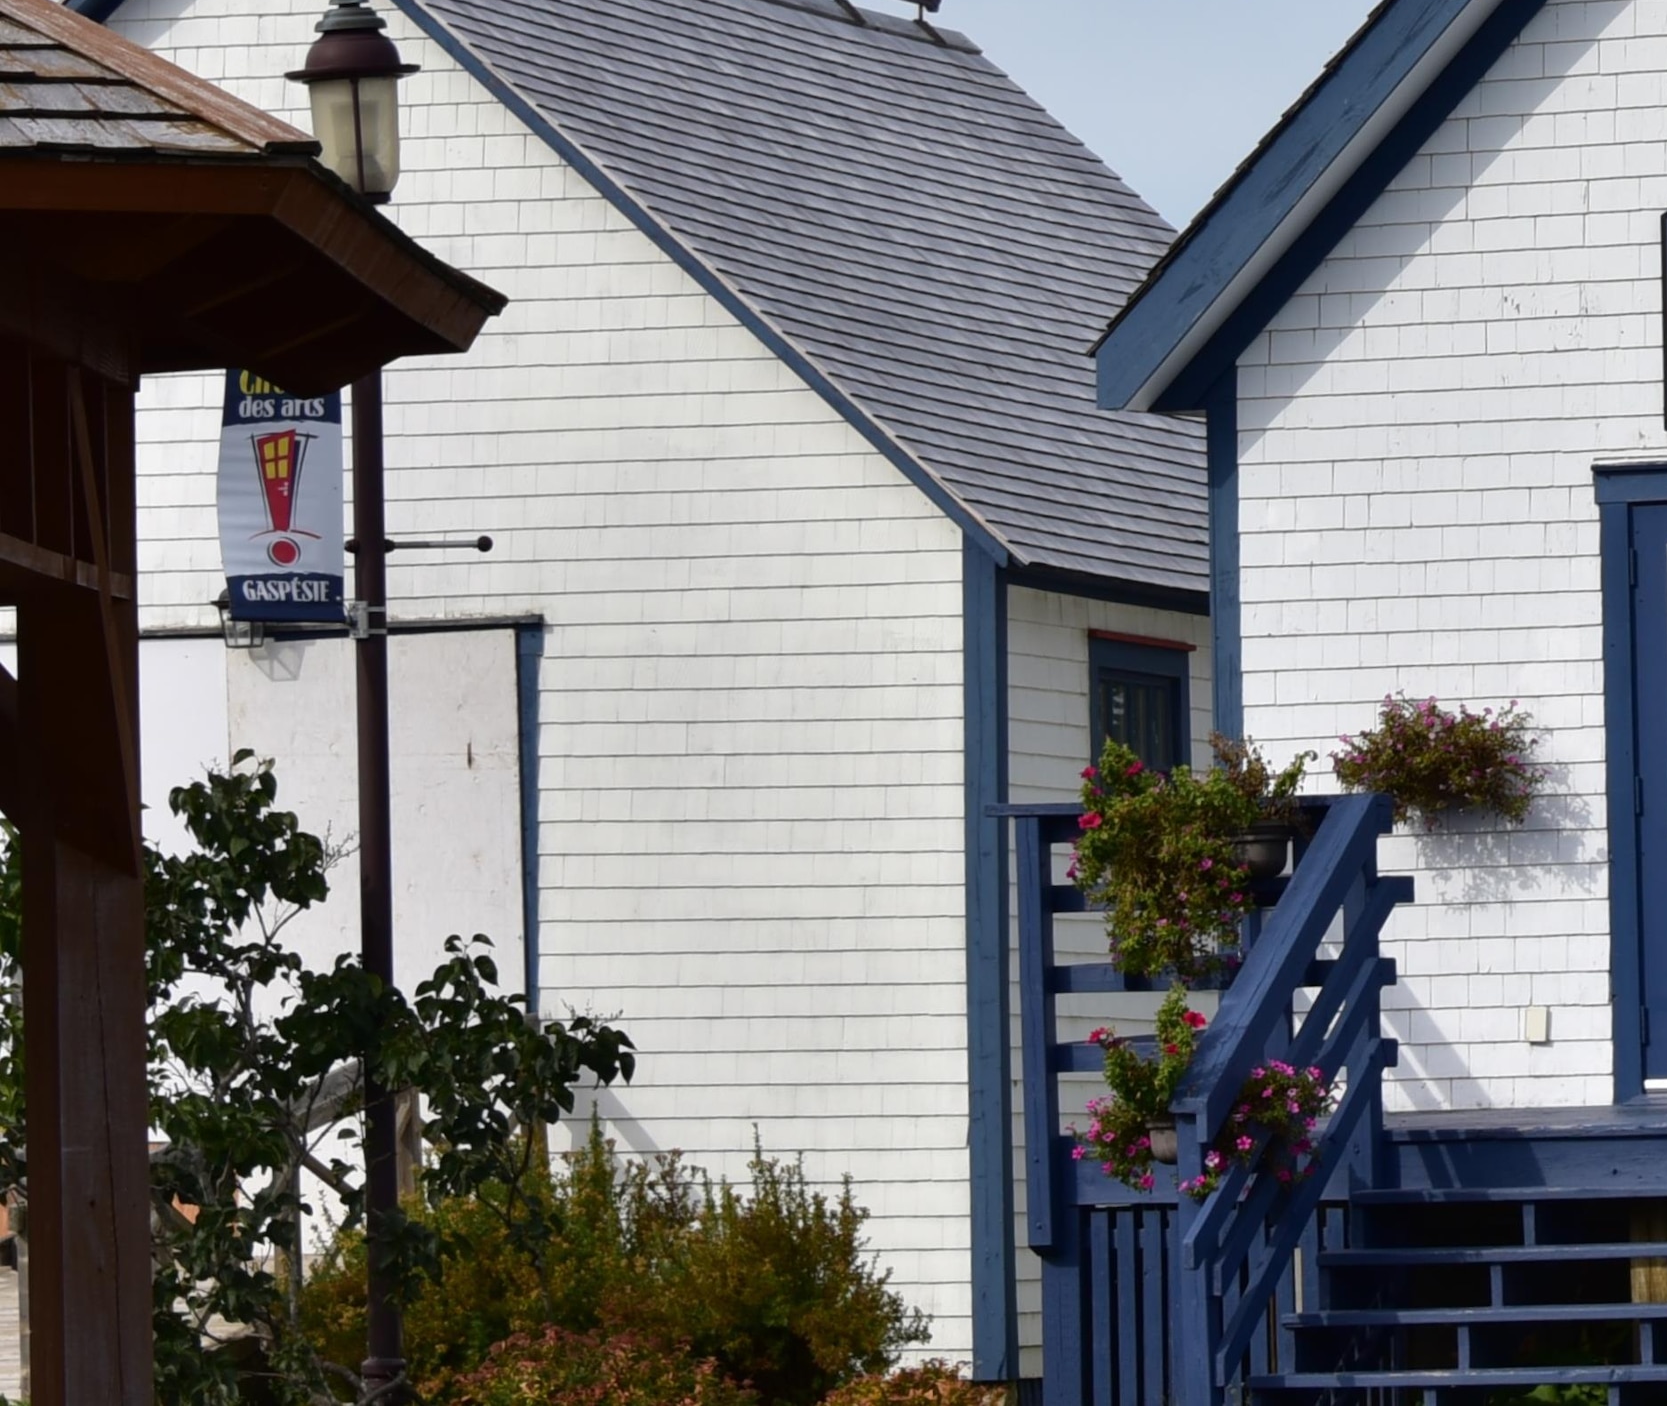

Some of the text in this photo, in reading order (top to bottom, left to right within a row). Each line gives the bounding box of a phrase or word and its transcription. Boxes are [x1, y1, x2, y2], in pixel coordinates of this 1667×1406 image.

[239, 395, 325, 418] des arts
[242, 577, 330, 602] GASPÉSIE
